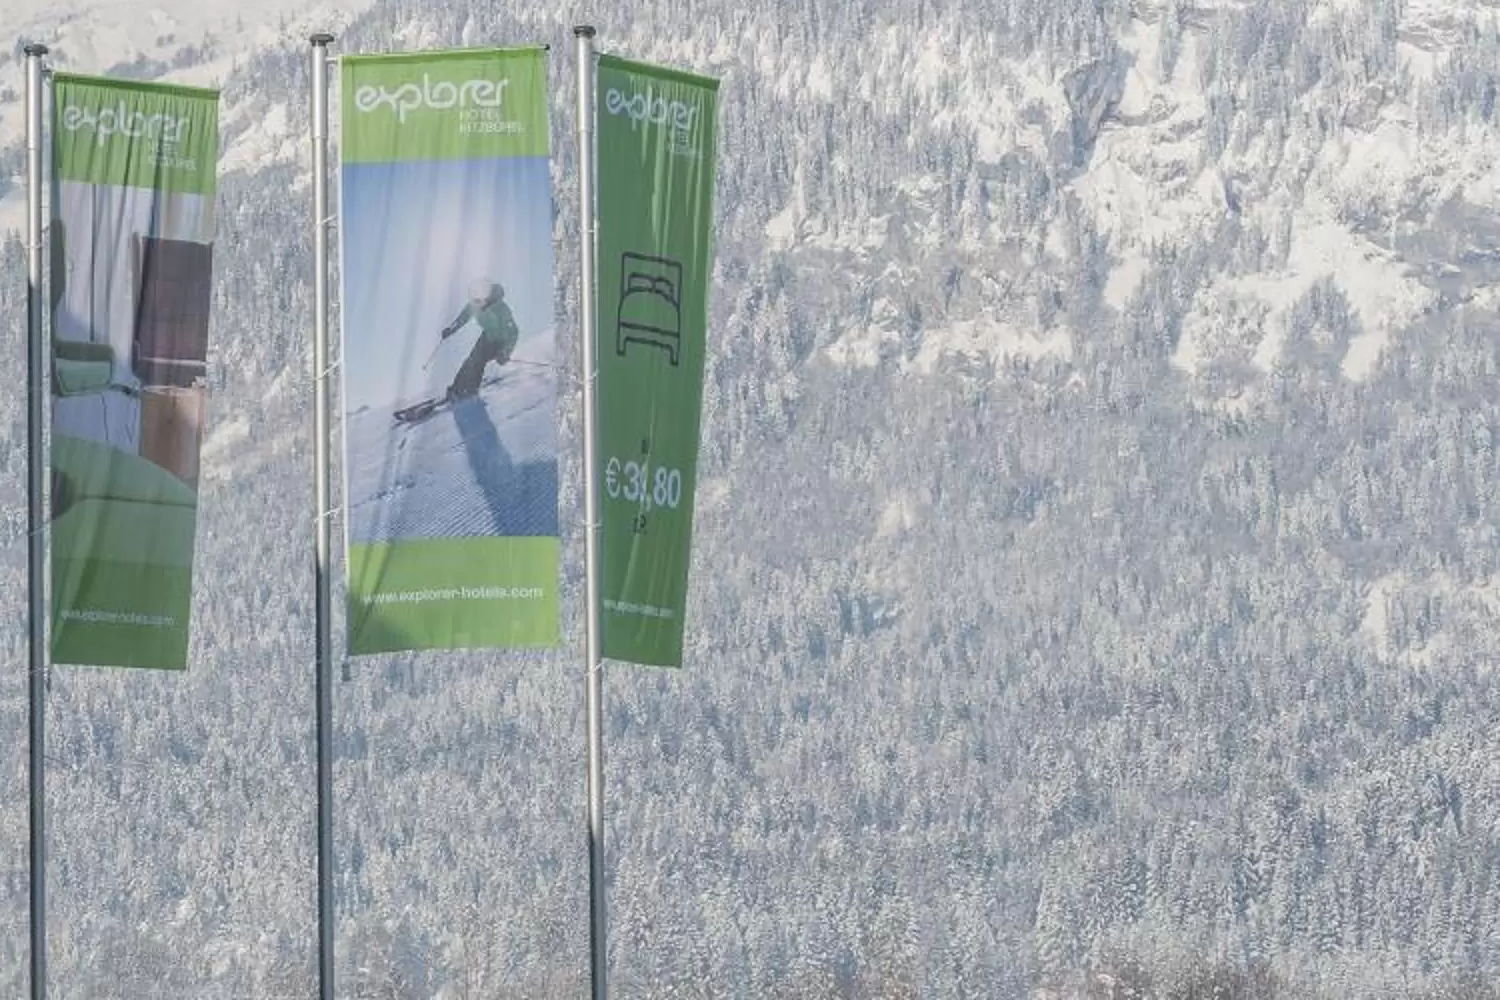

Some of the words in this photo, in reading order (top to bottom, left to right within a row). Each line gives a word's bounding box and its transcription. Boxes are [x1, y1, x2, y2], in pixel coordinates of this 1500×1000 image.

[355, 72, 510, 124] explorer
[605, 85, 697, 132] explorer
[63, 99, 190, 148] explorer
